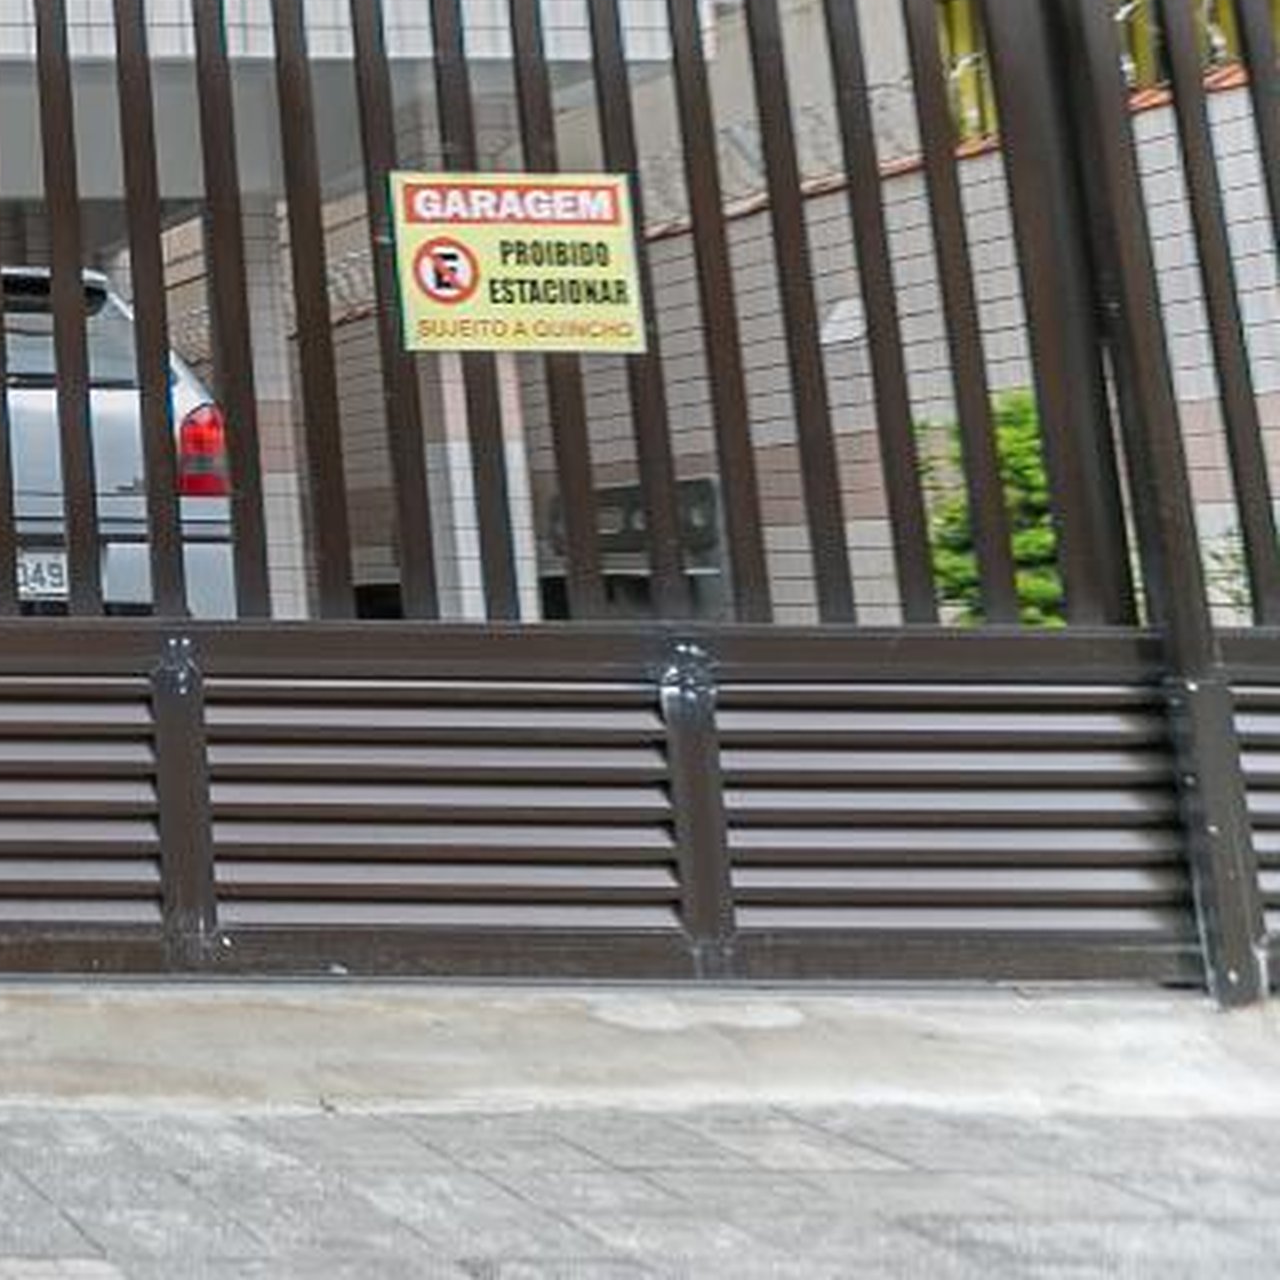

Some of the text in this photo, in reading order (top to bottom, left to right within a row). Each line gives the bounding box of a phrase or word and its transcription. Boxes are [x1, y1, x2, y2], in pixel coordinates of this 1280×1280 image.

[412, 188, 613, 220] GARAGEM
[499, 240, 610, 267] PROIBIDO
[489, 278, 631, 305] ESTACIONAR
